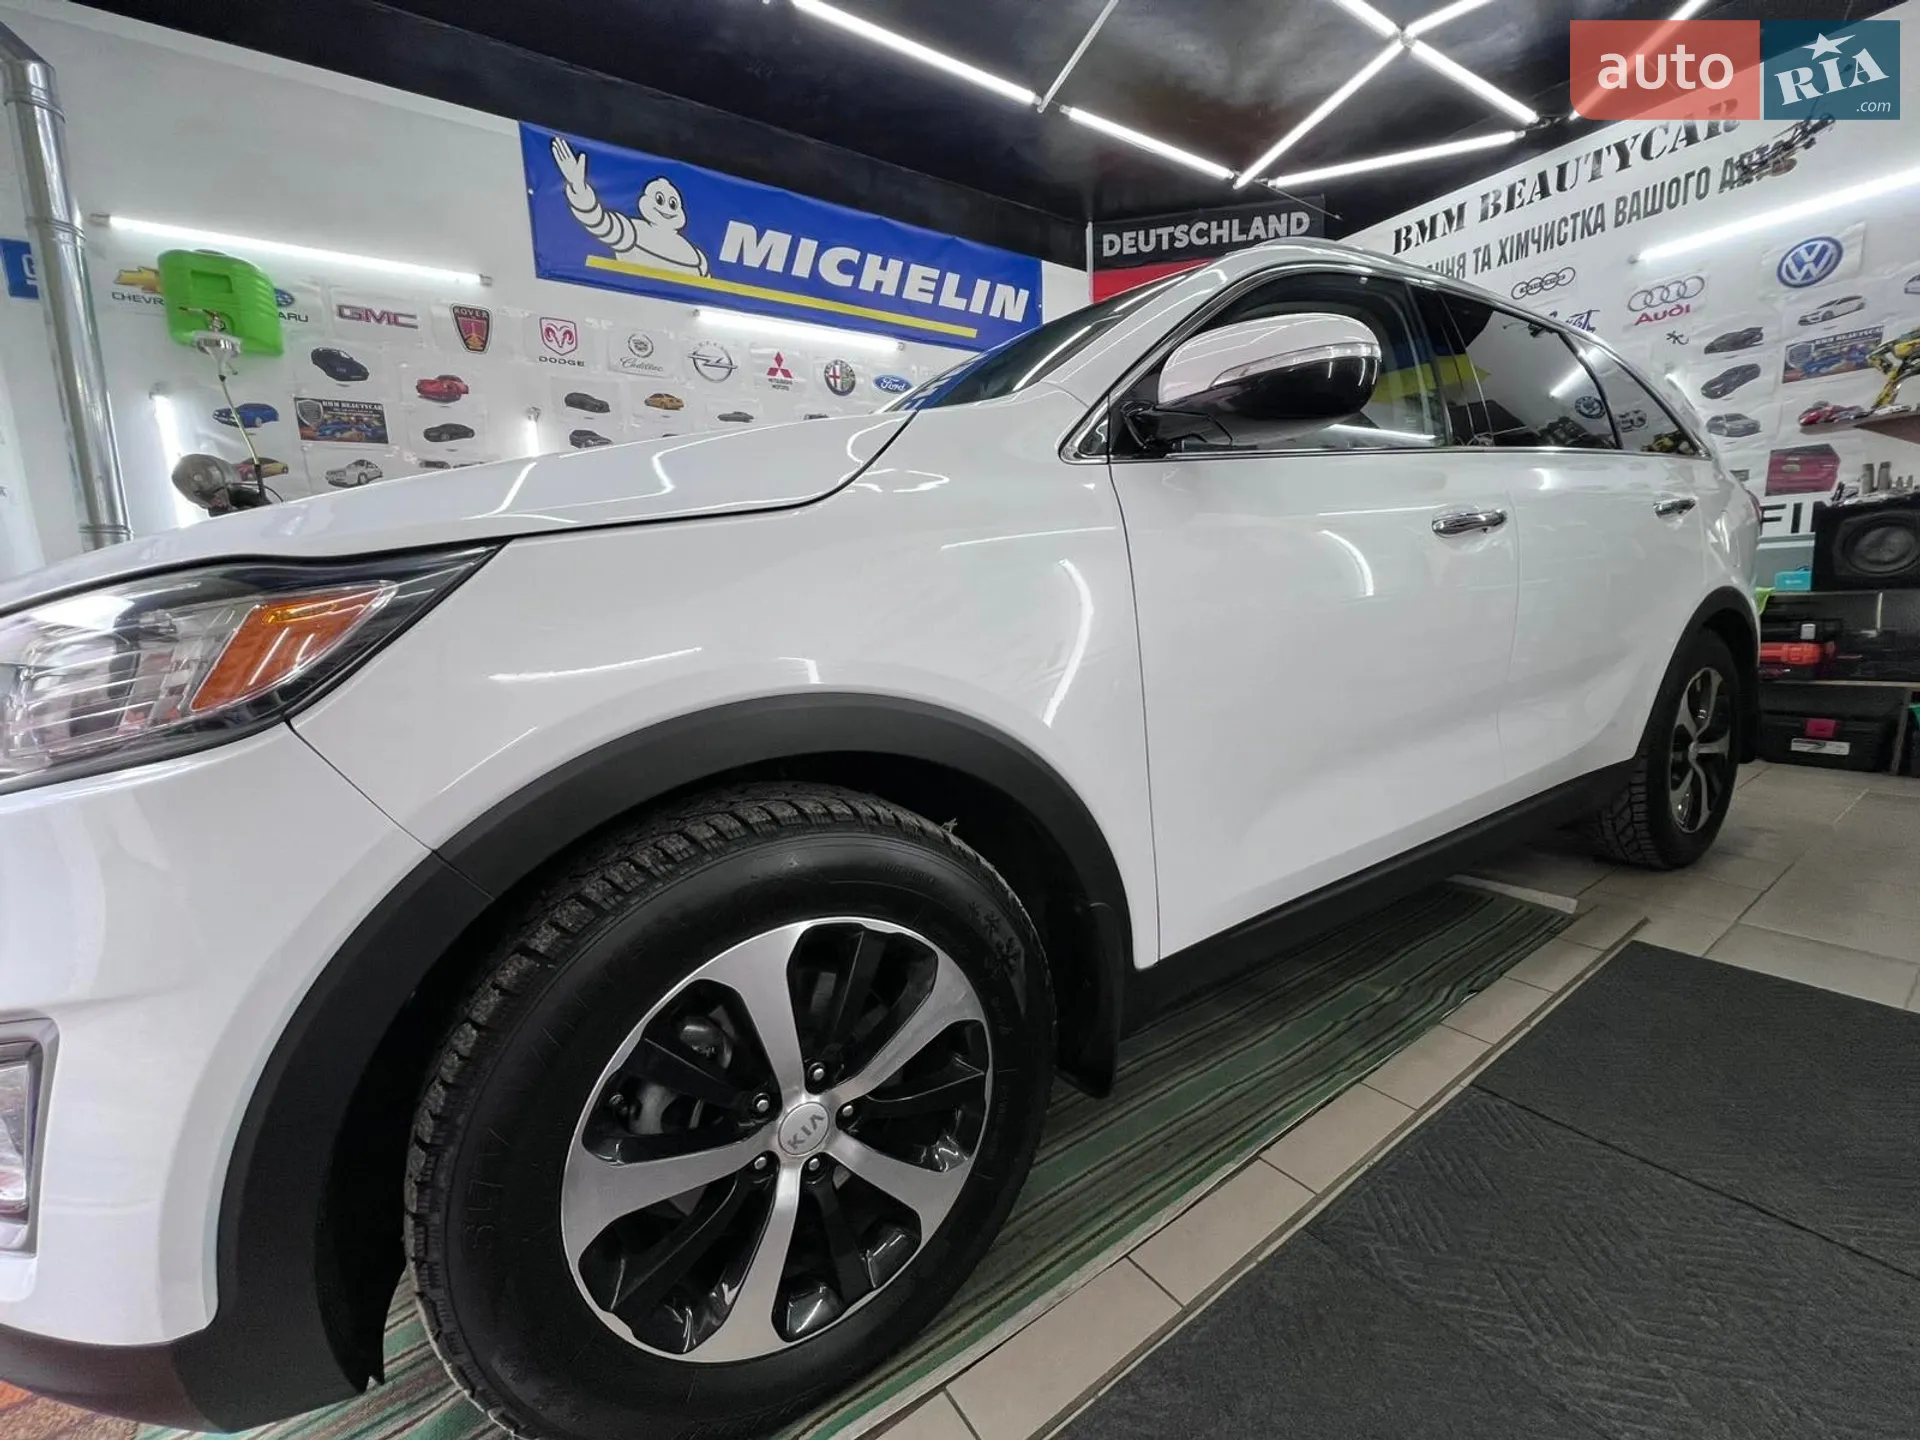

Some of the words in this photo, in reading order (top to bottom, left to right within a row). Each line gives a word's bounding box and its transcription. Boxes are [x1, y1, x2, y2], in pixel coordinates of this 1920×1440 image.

[1393, 201, 1467, 255] BMM
[1479, 98, 1740, 223] BEAUTYCAR
[1473, 243, 1492, 275] ТА
[1497, 202, 1606, 267] ХІМЧИСТКА
[1613, 165, 1711, 229] ВАШОГО
[1102, 211, 1310, 257] DEUTSCHLAND
[719, 219, 1030, 323] MICHELIN
[111, 291, 164, 306] CHEVR
[278, 311, 308, 323] ARU
[336, 304, 418, 329] GMC
[538, 356, 585, 367] DODGE
[619, 357, 664, 372] Cadillac
[879, 377, 905, 391] Ford
[787, 1113, 825, 1151] KIA
